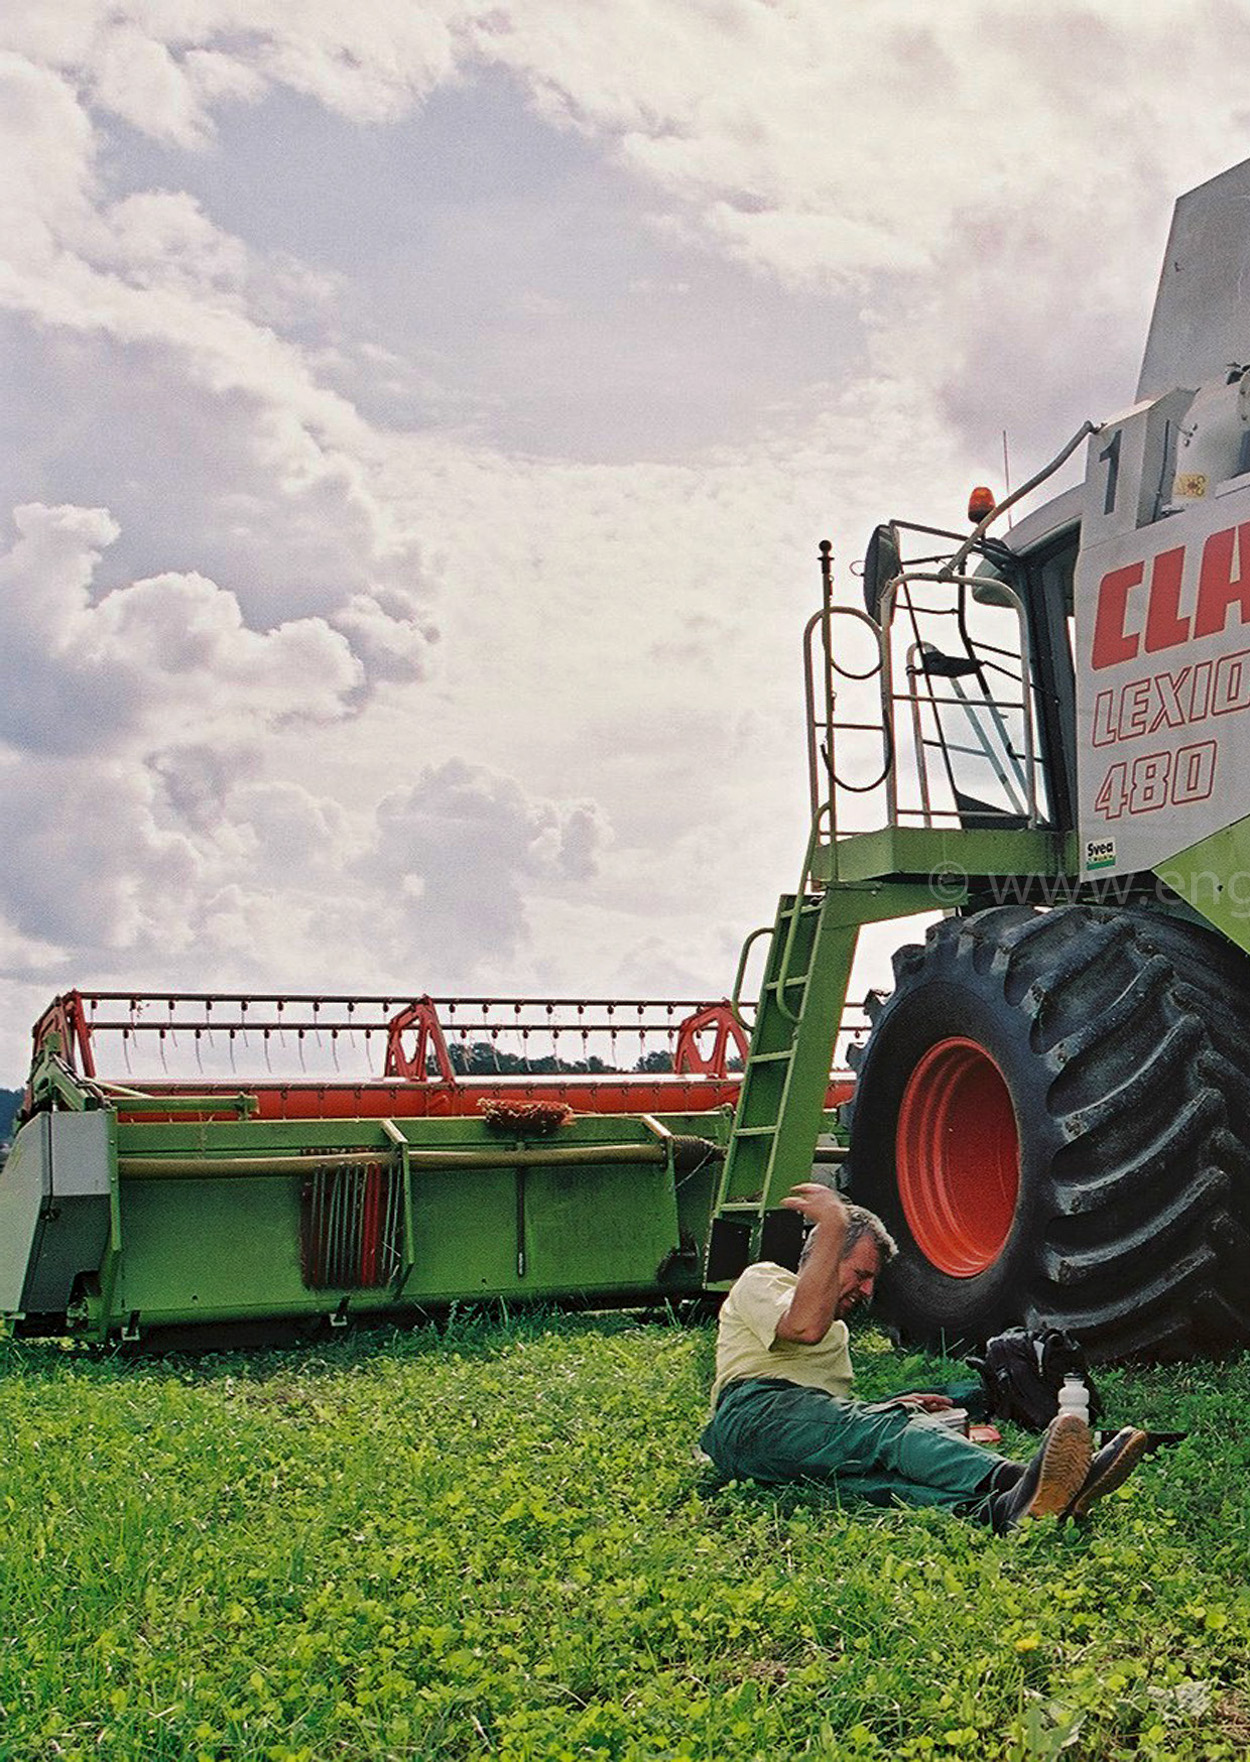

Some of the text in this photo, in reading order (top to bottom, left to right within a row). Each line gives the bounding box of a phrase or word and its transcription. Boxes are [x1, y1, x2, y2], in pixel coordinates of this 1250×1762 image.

[1099, 429, 1122, 515] 1
[1094, 739, 1217, 820] 480
[1087, 842, 1114, 857] Svea
